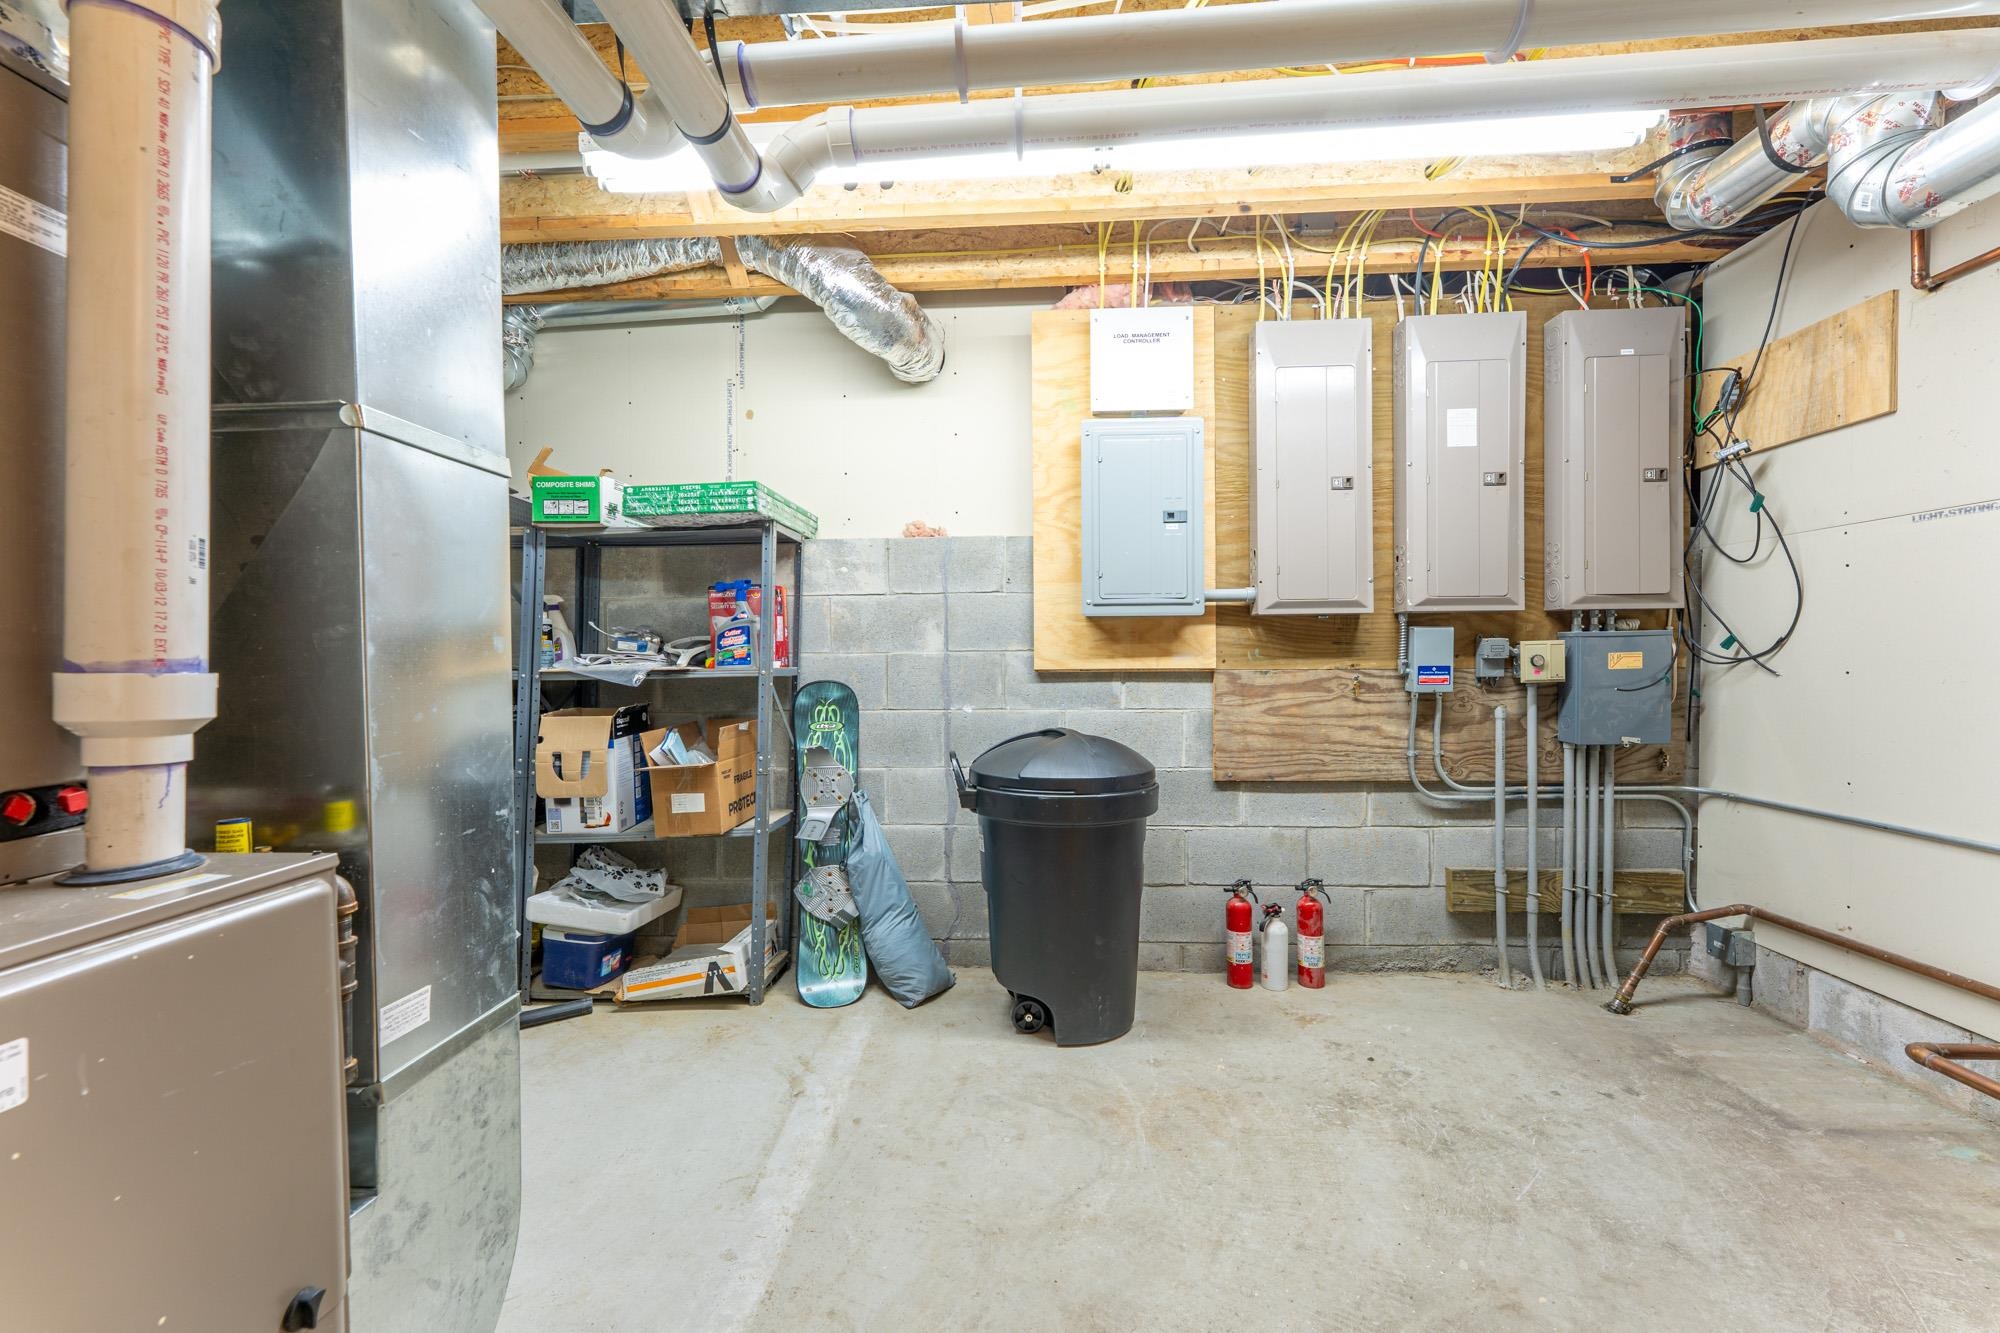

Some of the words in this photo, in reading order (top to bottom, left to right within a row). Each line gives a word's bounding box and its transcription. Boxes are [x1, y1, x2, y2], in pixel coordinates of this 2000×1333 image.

[156, 45, 171, 68] TYPE
[155, 78, 170, 96] SCH
[155, 98, 170, 109] 40
[155, 145, 170, 169] ASTM
[155, 228, 170, 246] PVC
[155, 249, 170, 269] 1120
[155, 271, 170, 285] PR
[155, 286, 170, 302] 260
[155, 303, 170, 319] PSI
[155, 445, 170, 466] ASTM
[155, 480, 170, 498] 1785
[535, 481, 574, 489] COMPOSITE
[155, 567, 170, 607] 10/03/12
[724, 629, 742, 637] Cutter
[733, 769, 753, 784] FRAGILE
